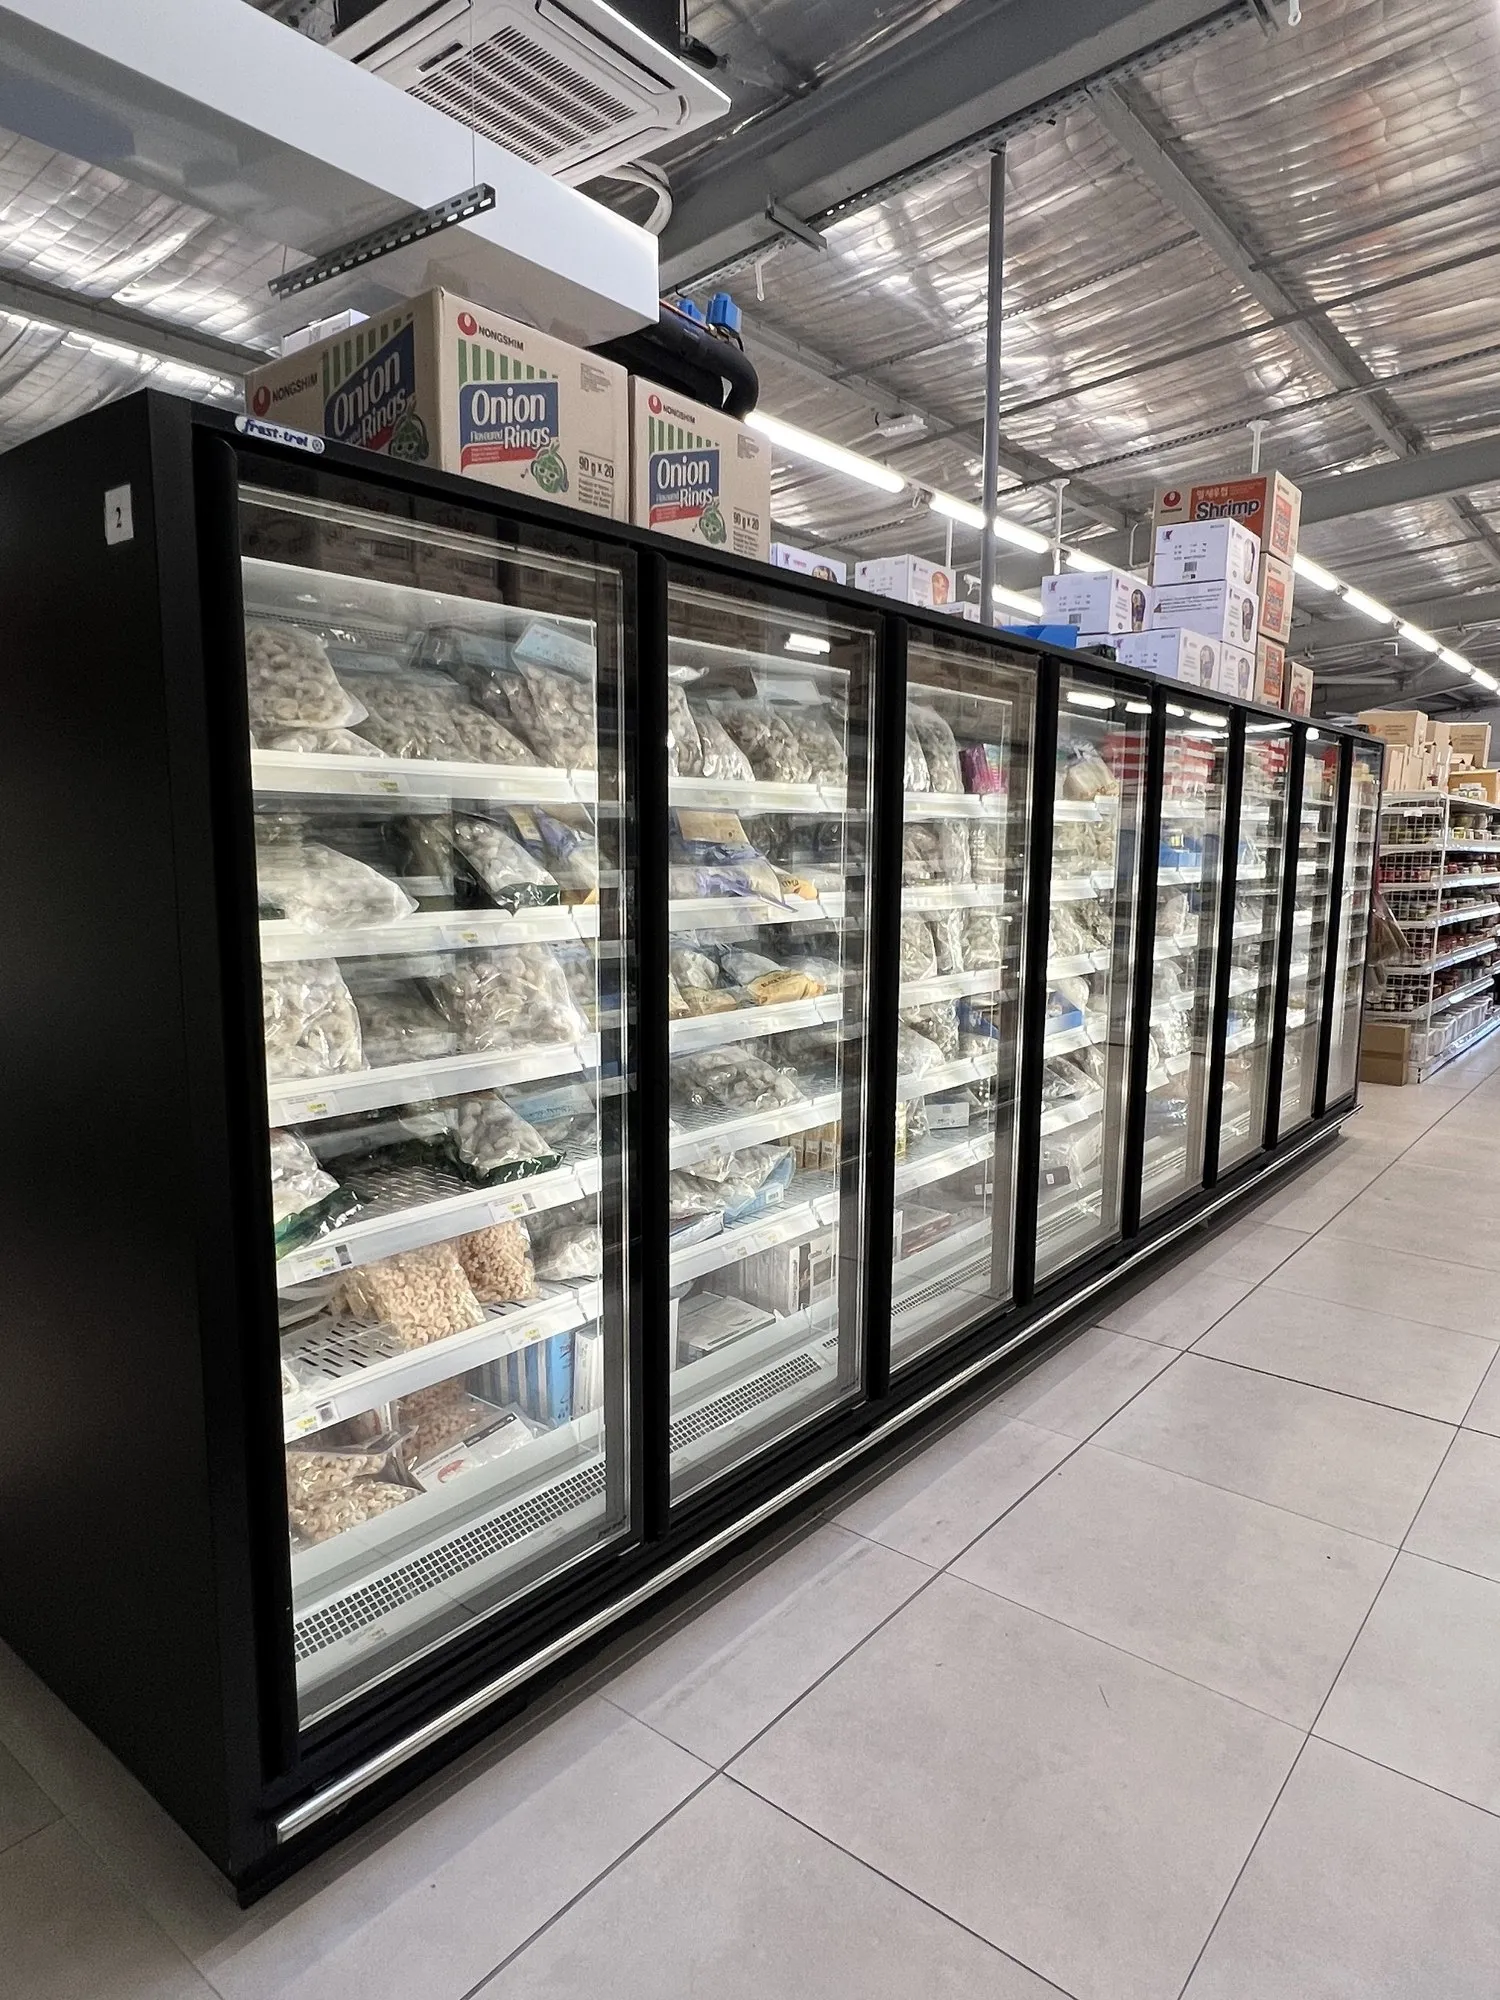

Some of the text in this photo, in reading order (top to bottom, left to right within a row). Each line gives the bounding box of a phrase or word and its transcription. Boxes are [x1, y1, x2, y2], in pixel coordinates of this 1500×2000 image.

[479, 326, 524, 351] NONGSHIM
[272, 372, 318, 402] NONGSHIM
[334, 352, 400, 436] Onion
[362, 388, 406, 446] Rings
[471, 387, 546, 426] Onion
[504, 424, 550, 450] Rings
[578, 456, 589, 471] 90
[591, 462, 596, 477] g
[604, 463, 614, 478] 20
[657, 455, 710, 489] Onion
[680, 487, 713, 508] Rings
[1196, 499, 1260, 519] Shrimp
